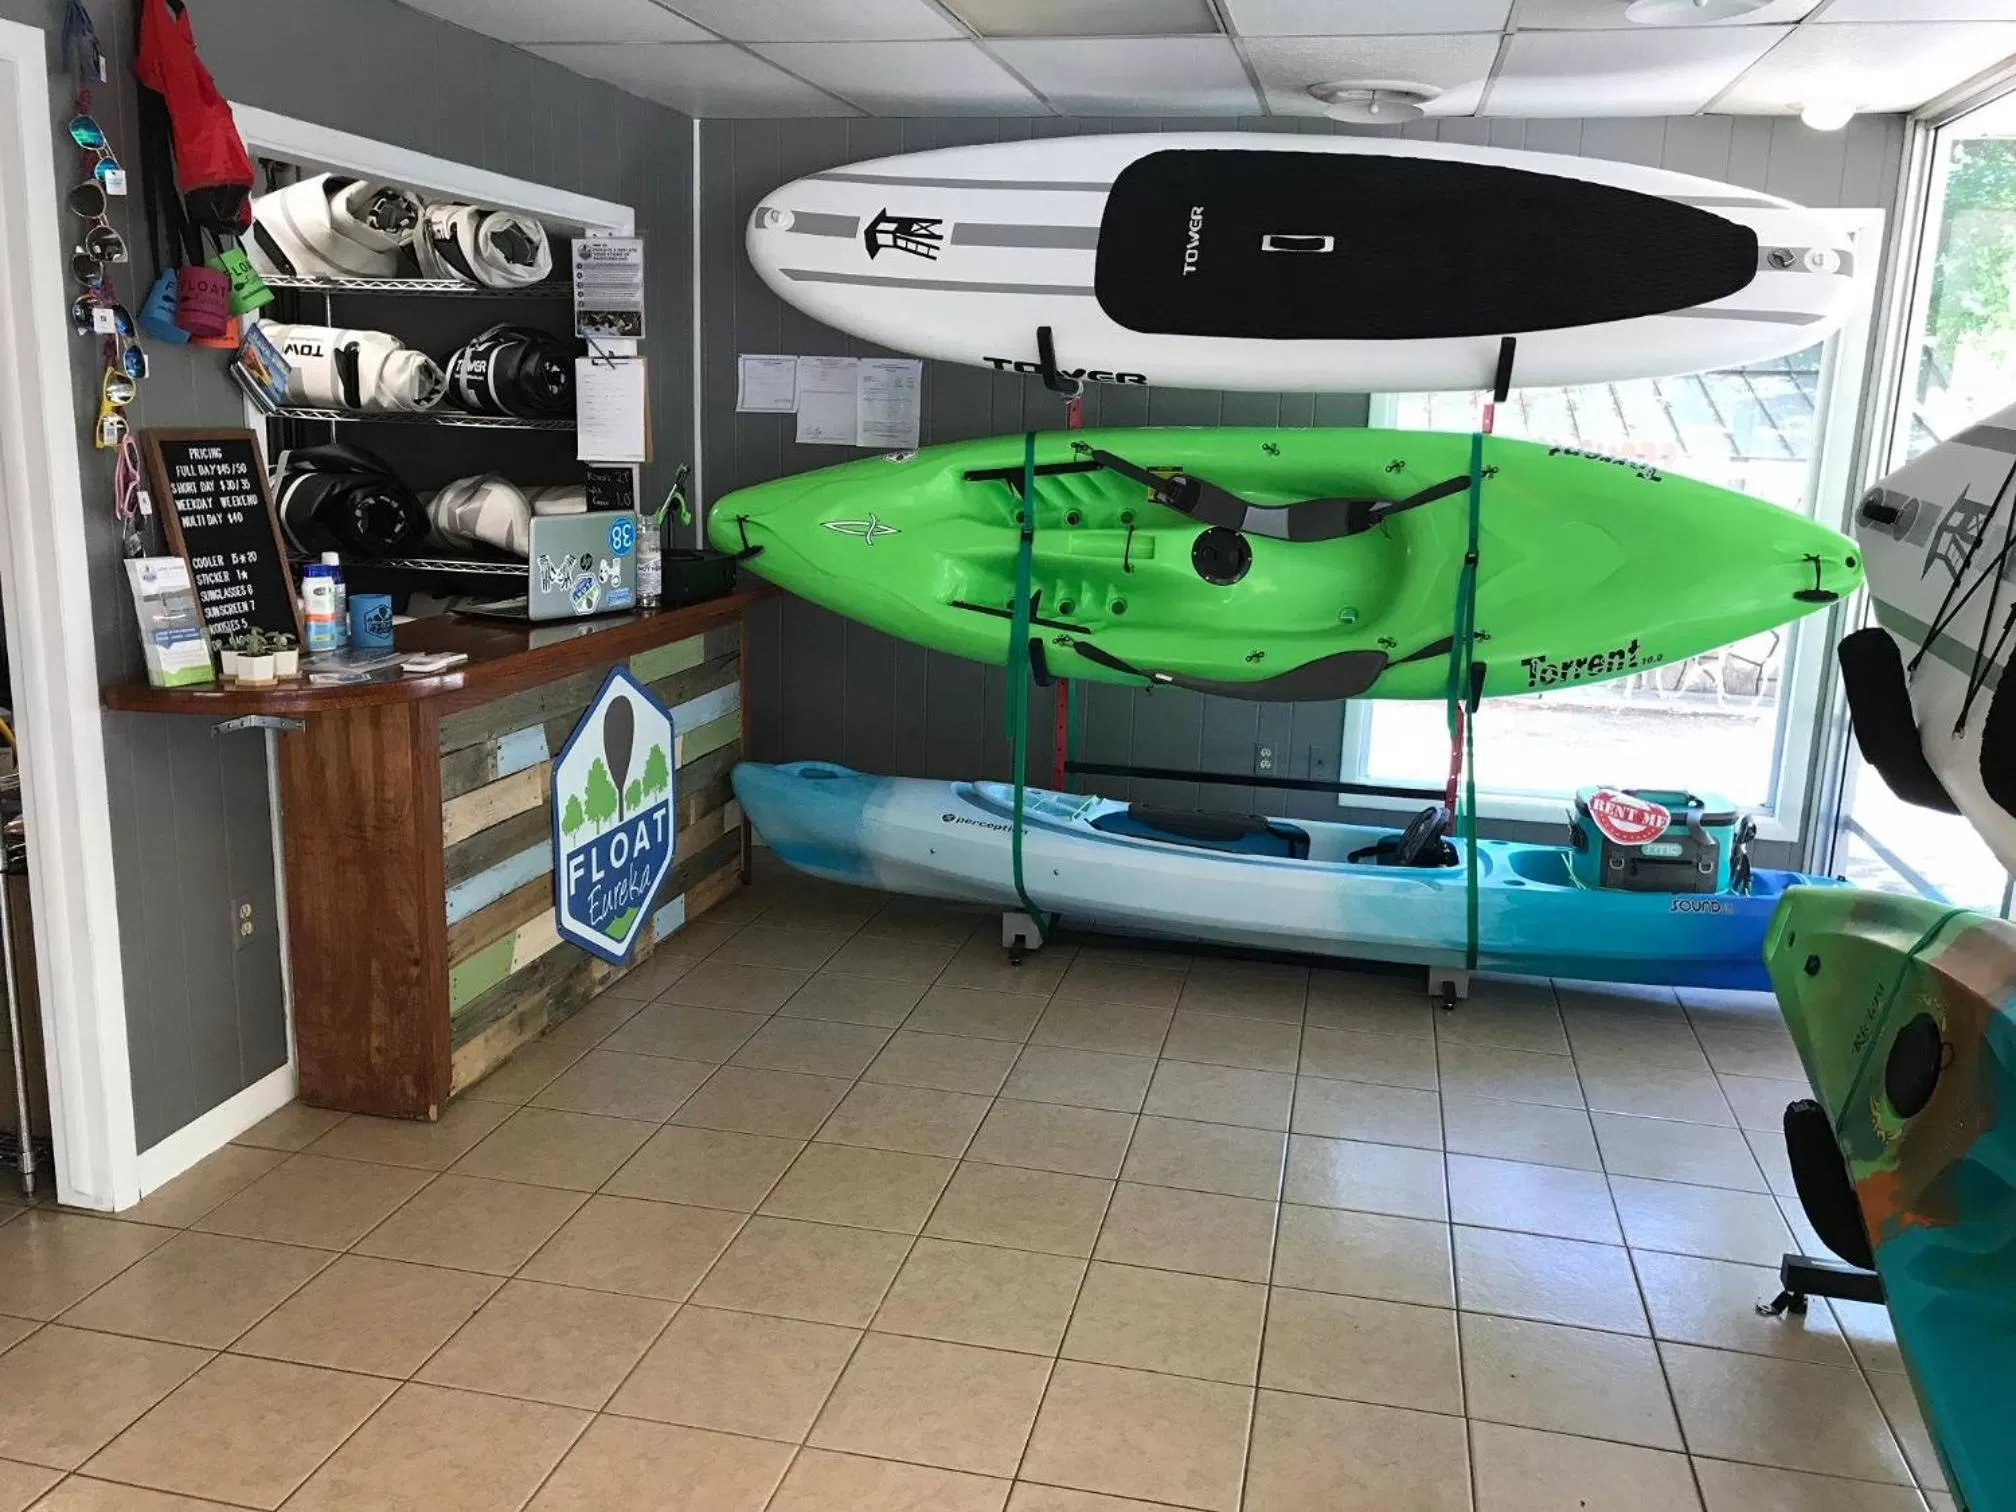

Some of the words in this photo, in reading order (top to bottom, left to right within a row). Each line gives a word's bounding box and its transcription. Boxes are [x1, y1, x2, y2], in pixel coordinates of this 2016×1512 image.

[1183, 206, 1204, 276] TOWER
[456, 360, 488, 373] TWER
[188, 447, 222, 460] PRICING
[176, 464, 198, 477] FULL
[198, 463, 216, 476] DAY
[170, 481, 198, 494] SHORT
[200, 480, 215, 493] DAY
[175, 497, 213, 511] WEEKDAY
[219, 494, 259, 509] WEEKEND
[206, 512, 223, 526] DAY
[192, 554, 225, 569] COOLER
[195, 570, 231, 586] STICKER
[200, 585, 247, 602] SUNGLASSES
[204, 600, 249, 620] SUNSCREEN
[249, 599, 256, 612] 7
[241, 617, 249, 630] 5
[1521, 639, 1640, 688] Torrent
[1592, 797, 1638, 823] RENT
[1641, 813, 1668, 829] ME
[955, 816, 1029, 836] percepti
[568, 807, 667, 897] FLOAT
[587, 861, 651, 926] Eureka
[1670, 899, 1721, 913] SOUND
